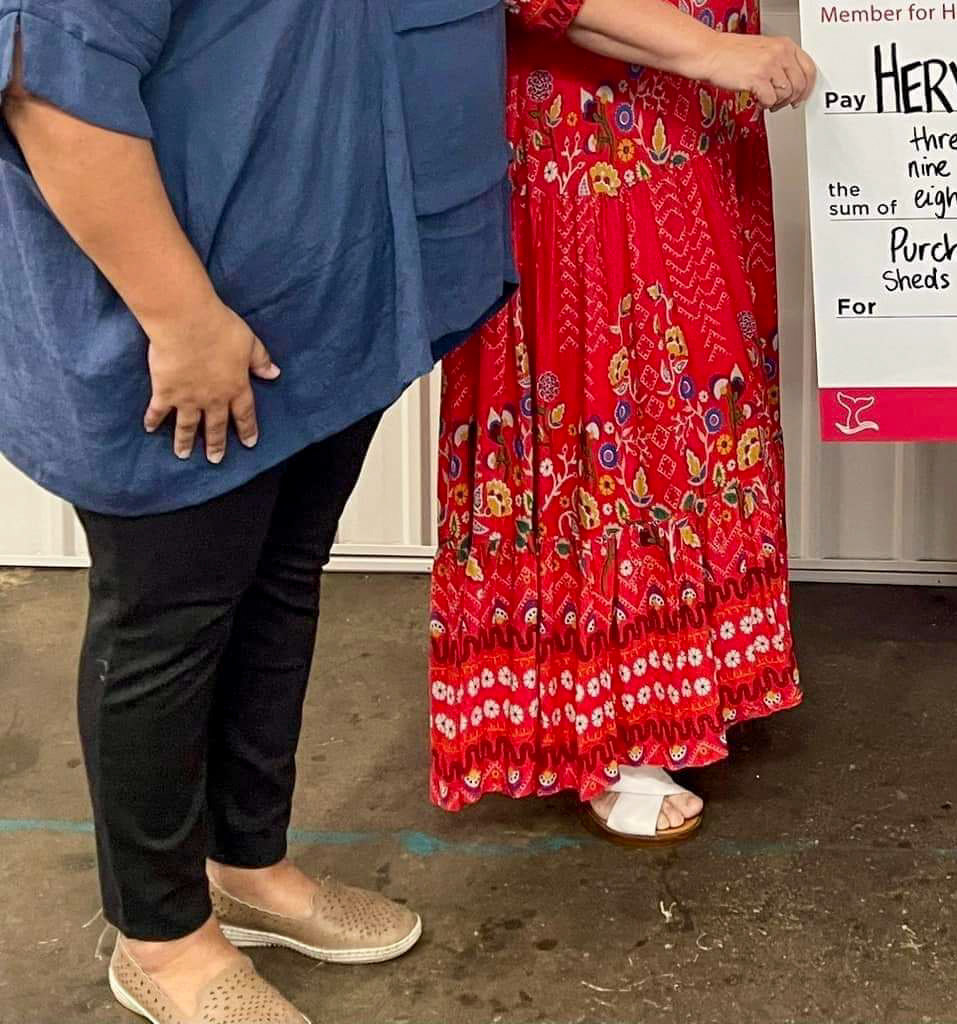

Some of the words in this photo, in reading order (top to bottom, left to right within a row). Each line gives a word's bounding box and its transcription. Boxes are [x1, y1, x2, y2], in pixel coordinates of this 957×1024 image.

[820, 4, 902, 23] Member
[909, 3, 935, 21] for
[825, 91, 866, 112] Pay
[908, 156, 951, 178] nine
[829, 183, 860, 197] the
[829, 203, 869, 215] sum
[877, 200, 898, 215] of
[838, 298, 876, 315] For
